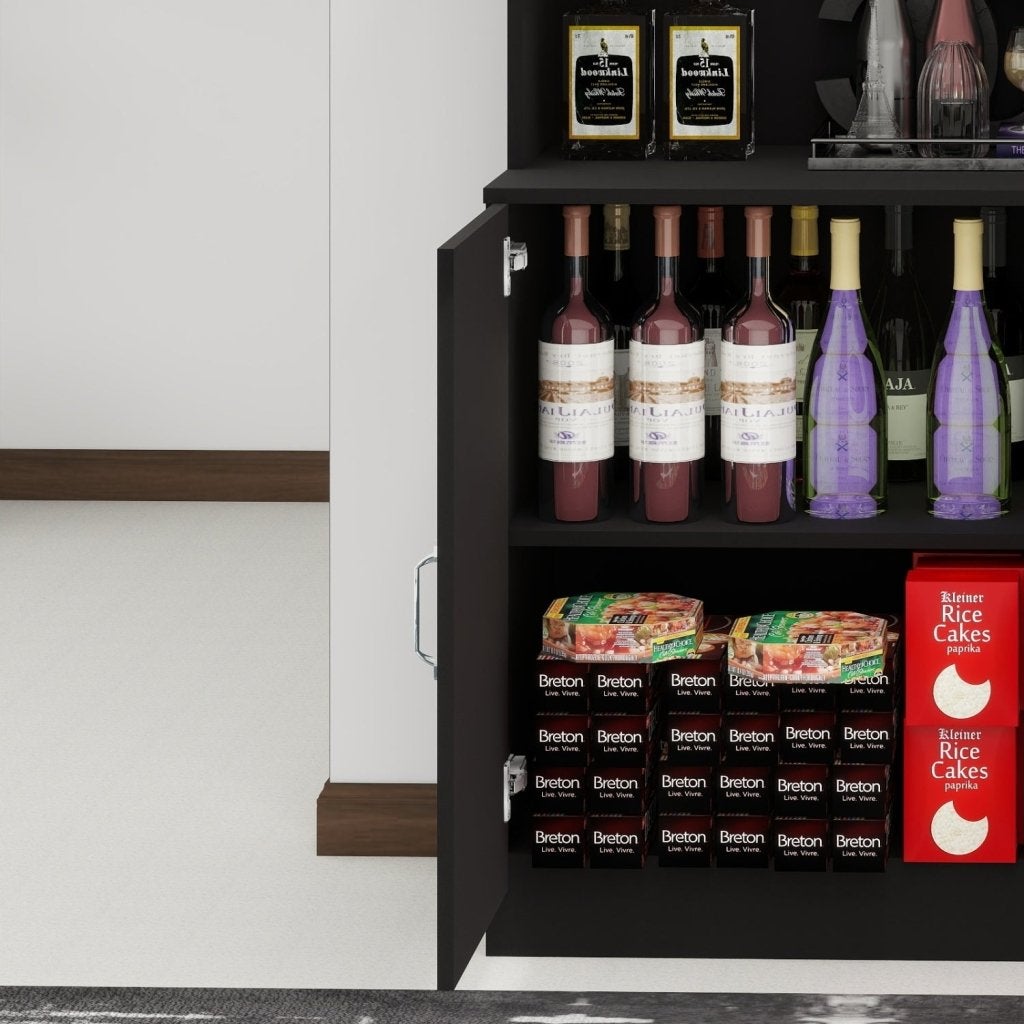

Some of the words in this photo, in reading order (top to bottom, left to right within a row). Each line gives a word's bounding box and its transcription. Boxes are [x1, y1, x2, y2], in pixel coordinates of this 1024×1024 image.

[940, 591, 984, 603] Kleiner
[942, 606, 982, 622] Rice
[933, 624, 991, 642] Cakes
[539, 674, 584, 688] Breton
[671, 673, 716, 687] Breton
[671, 729, 716, 743] Breton
[844, 727, 889, 741] Breton
[940, 742, 980, 760] Rice
[931, 761, 989, 780] Cakes
[593, 776, 638, 790] Breton
[720, 775, 765, 789] Breton
[944, 781, 979, 792] paprika
[535, 830, 580, 844] Breton
[836, 834, 881, 848] Breton
